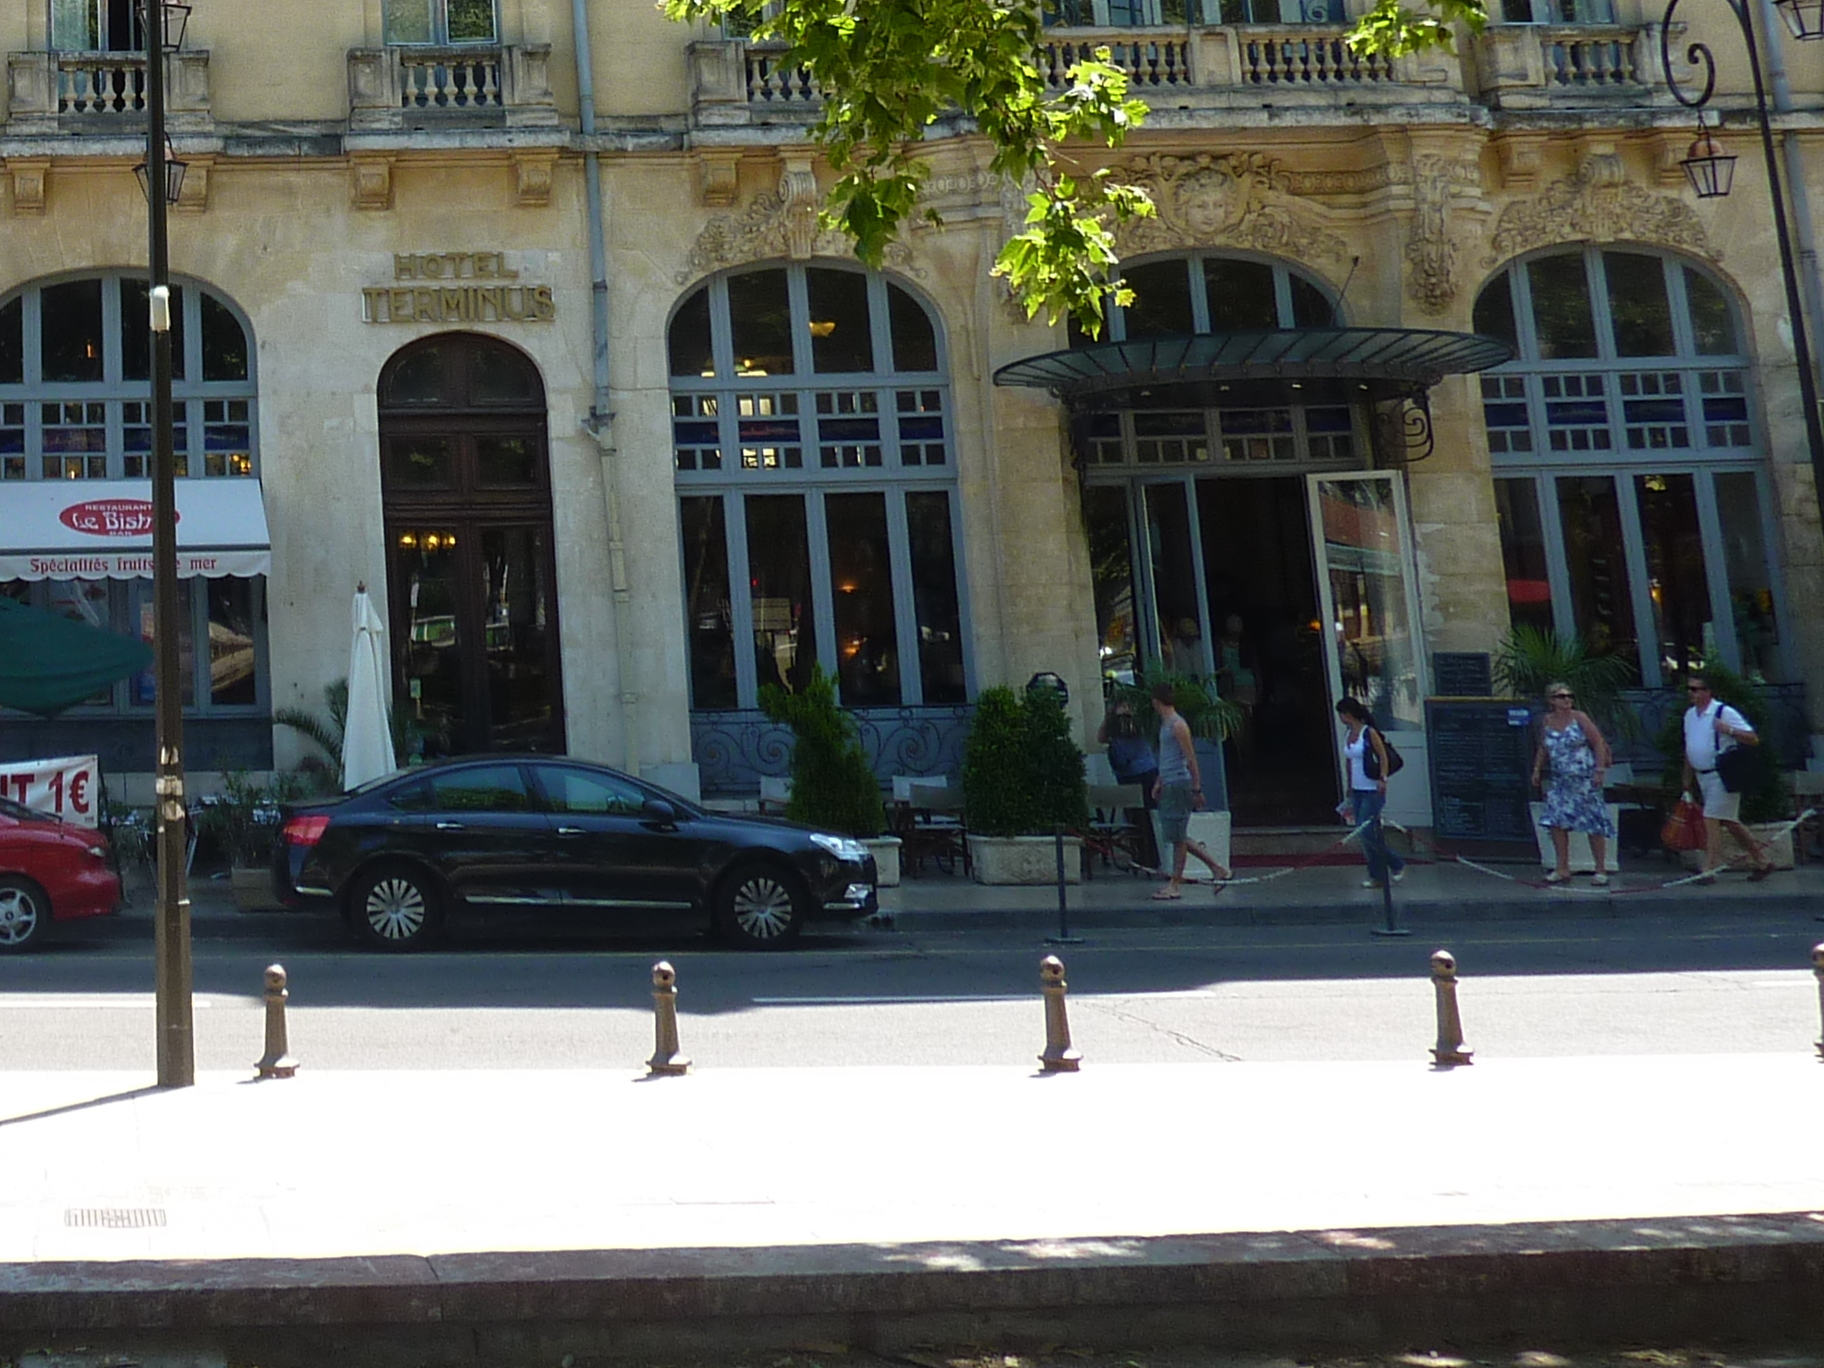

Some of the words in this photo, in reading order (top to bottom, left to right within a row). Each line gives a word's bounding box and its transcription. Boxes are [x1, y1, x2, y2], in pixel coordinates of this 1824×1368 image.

[394, 251, 519, 280] HOTEL
[361, 285, 556, 324] TERMINUS
[84, 503, 153, 512] RESTAURANT
[72, 512, 99, 530] Le
[102, 511, 154, 530] Bistr
[29, 557, 109, 574] Spécialités
[116, 557, 155, 572] fruits
[190, 557, 218, 570] mer
[48, 770, 90, 815] 1€
